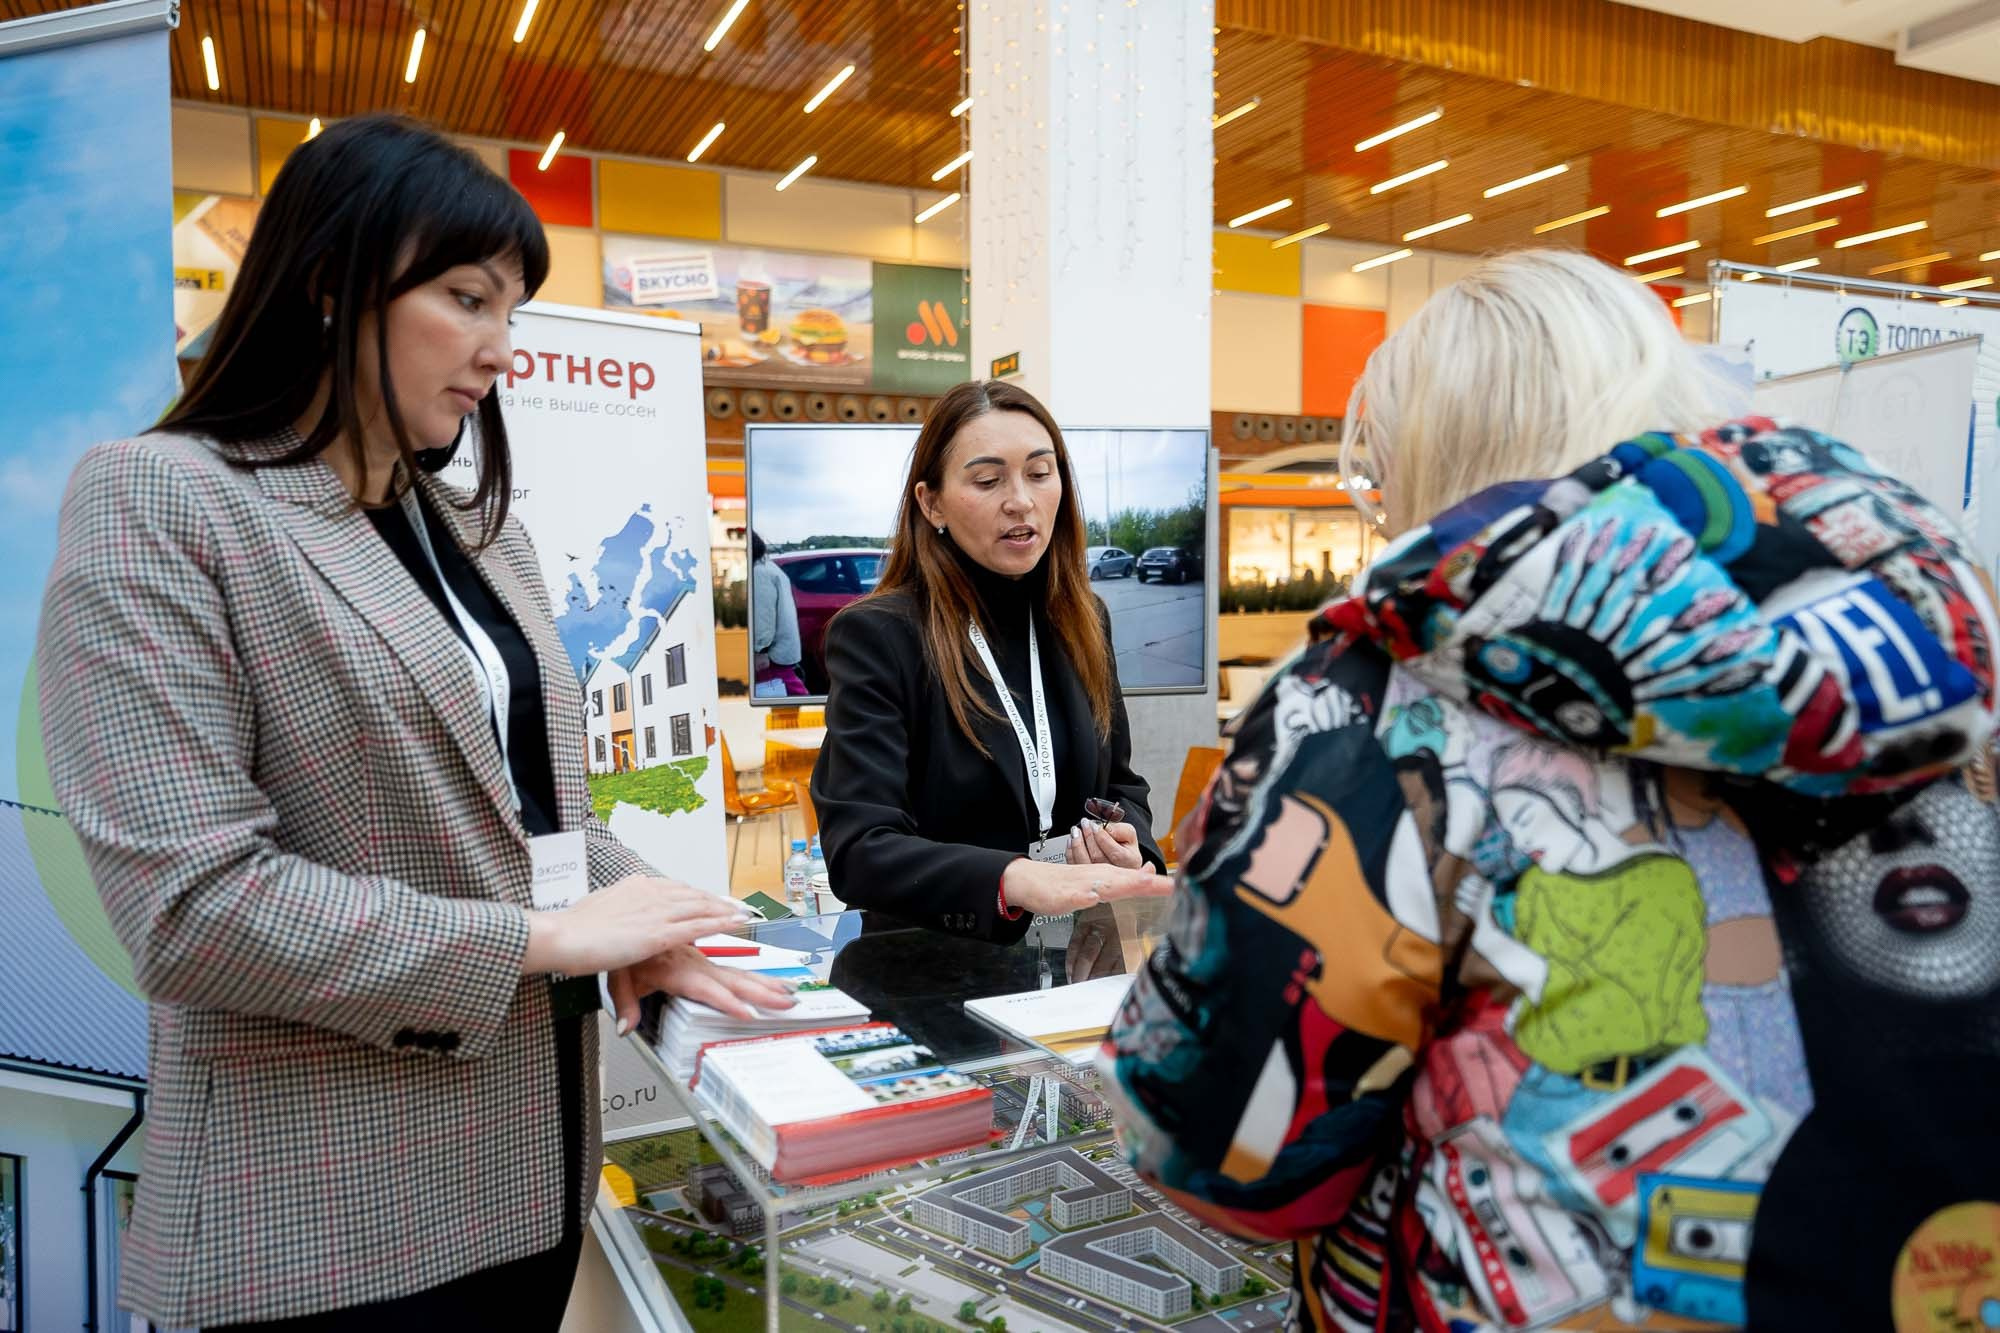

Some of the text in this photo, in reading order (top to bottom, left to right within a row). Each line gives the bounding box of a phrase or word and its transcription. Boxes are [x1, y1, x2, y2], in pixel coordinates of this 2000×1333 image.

[1847, 329, 1870, 356] ТЭ
[521, 396, 544, 409] не
[550, 398, 600, 414] выше
[604, 404, 657, 418] сосен
[1022, 737, 1040, 778] ЭКСПО
